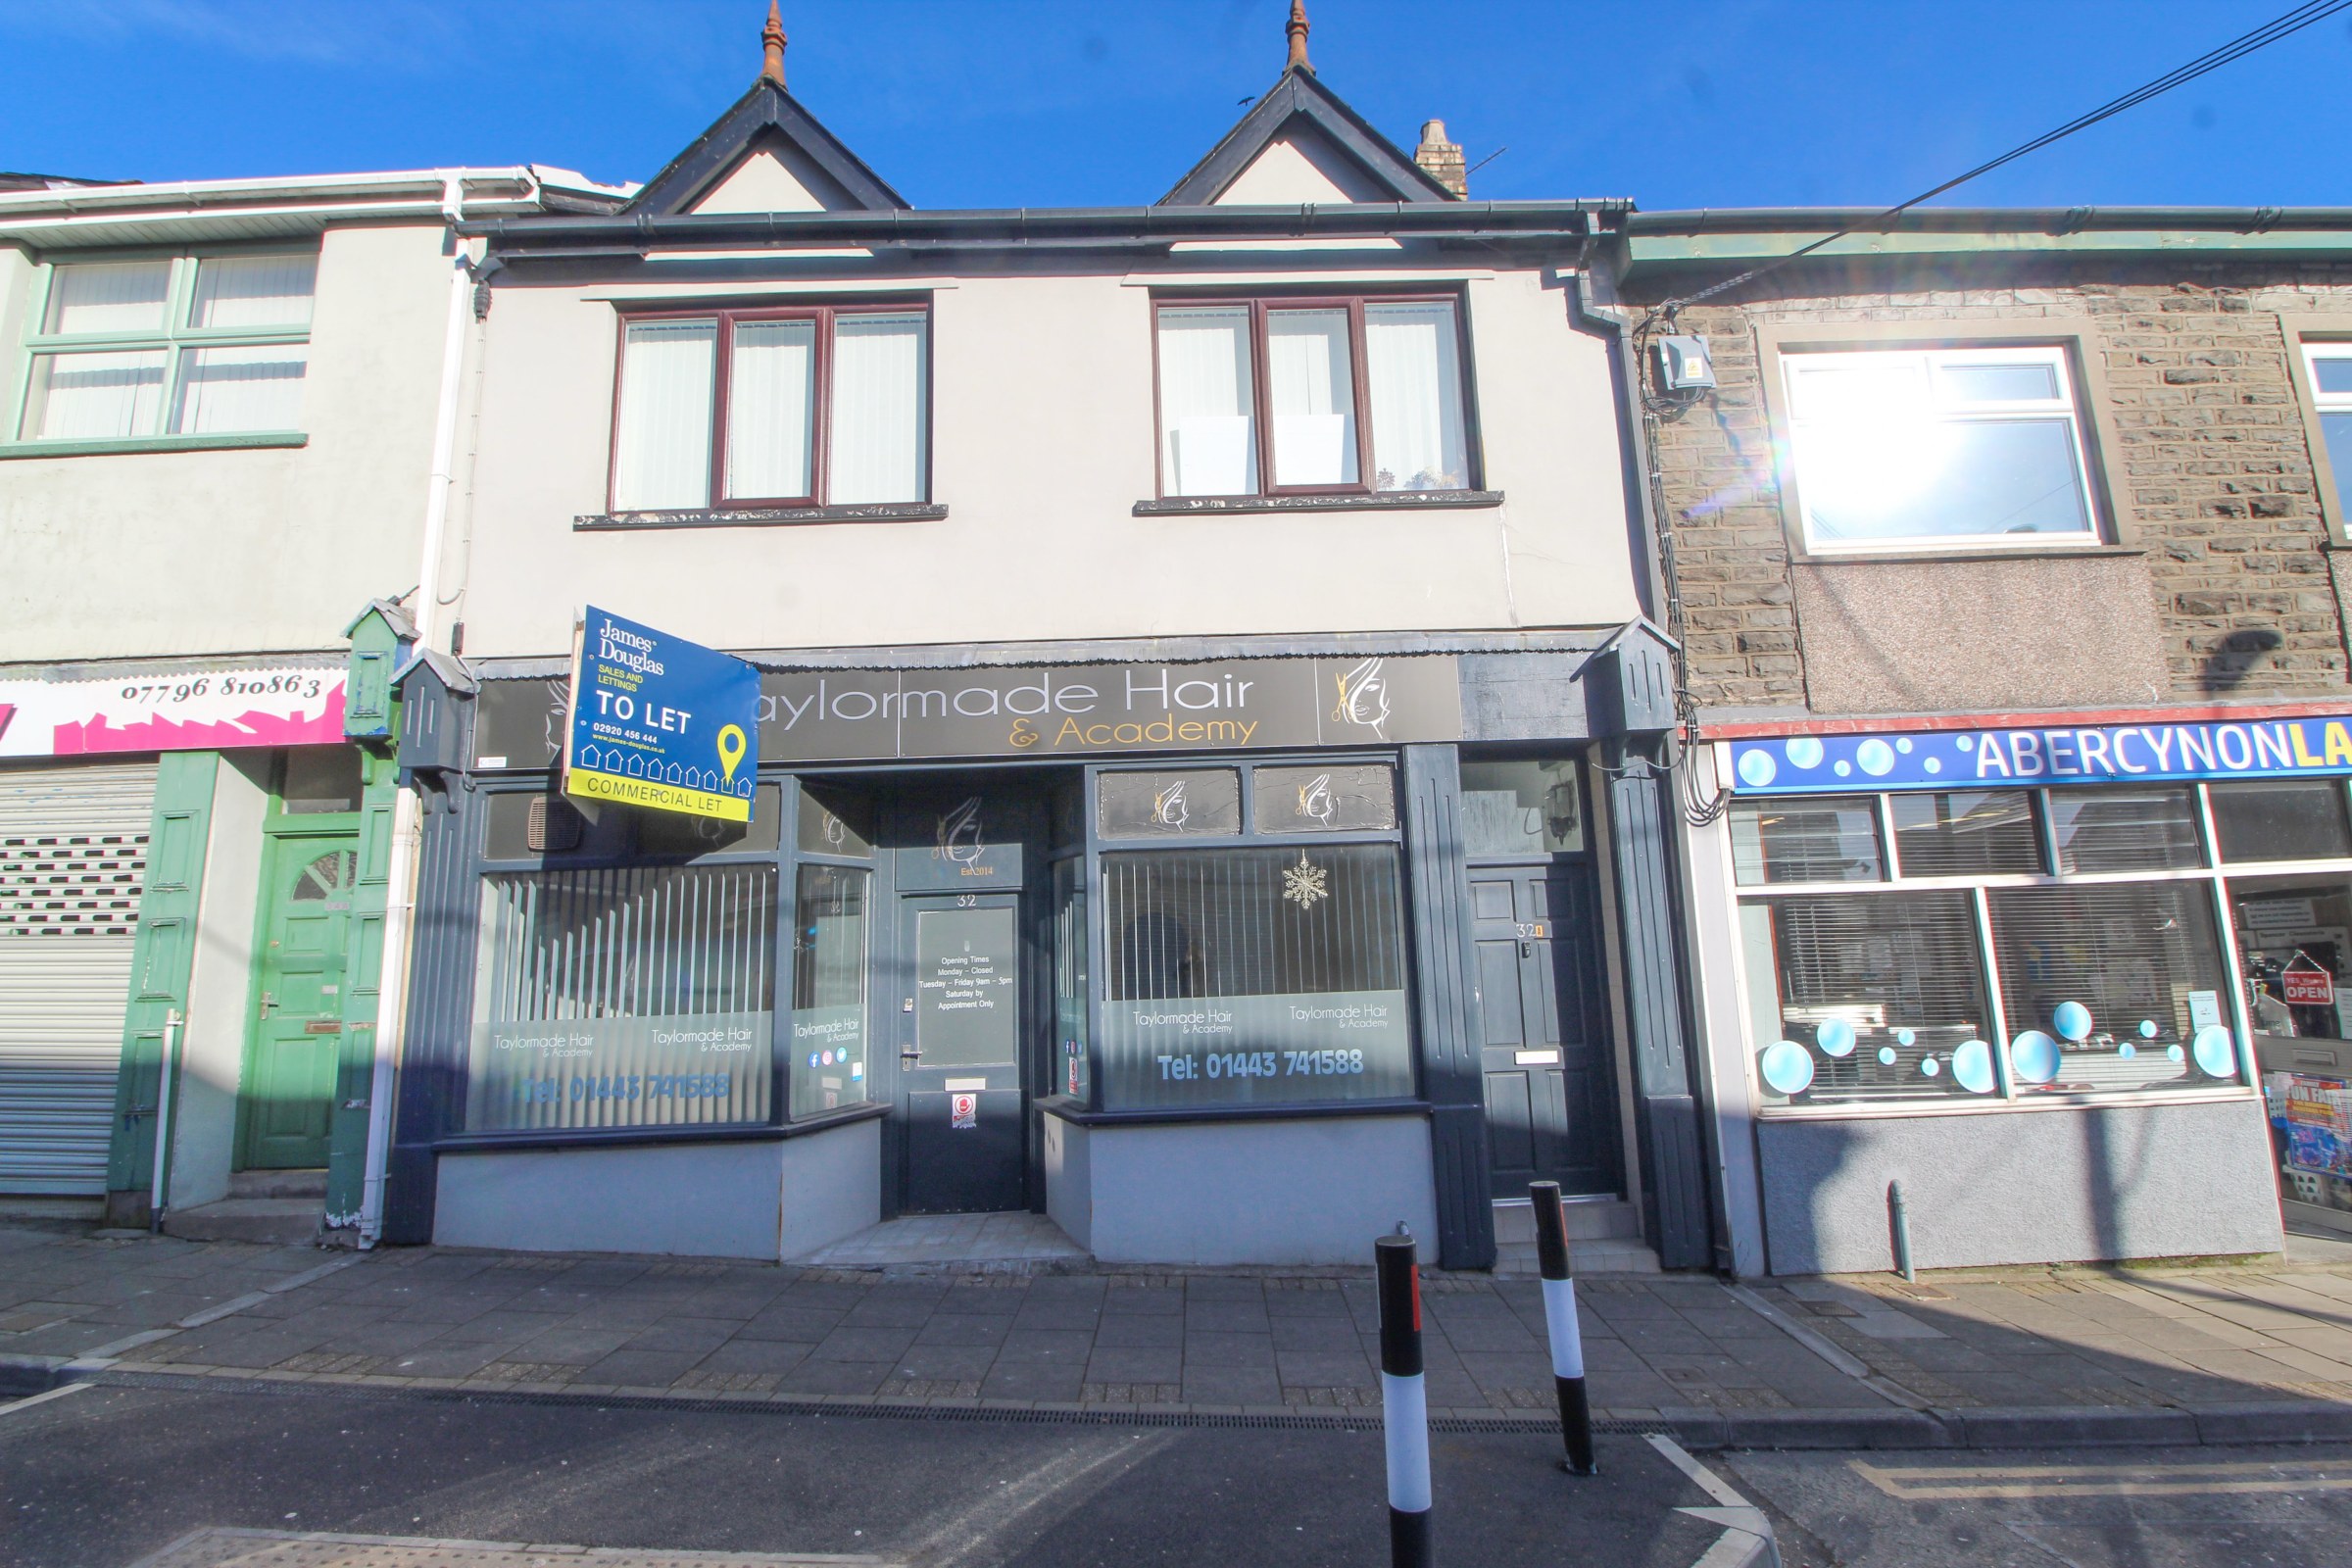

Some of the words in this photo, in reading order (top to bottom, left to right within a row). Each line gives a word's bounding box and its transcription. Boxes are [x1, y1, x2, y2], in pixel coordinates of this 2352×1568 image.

[599, 638, 664, 676] Douglas
[598, 674, 637, 692] LETTINGS
[599, 664, 625, 679] SALES
[626, 669, 643, 684] AND
[122, 677, 210, 705] 07796
[220, 674, 321, 699] 810863
[760, 671, 1099, 730] aylormade
[1125, 668, 1254, 711] Hair
[596, 689, 634, 720] TO
[646, 702, 692, 735] LET
[593, 722, 622, 736] 02920
[624, 729, 640, 740] 456
[643, 734, 658, 744] 444
[1008, 717, 1039, 748] &
[1054, 712, 1259, 747] Academy
[592, 733, 665, 755] www.james-douglas.co.uk
[587, 777, 692, 808] COMMERCIAL
[698, 796, 722, 812] LET
[956, 894, 977, 907] 32
[941, 956, 968, 966] Opening
[937, 967, 962, 977] Monday
[971, 966, 994, 975] Closed
[919, 980, 947, 989] Tuesday
[954, 978, 974, 988] Friday
[975, 977, 990, 986] 9am
[998, 977, 1013, 986] 5pm
[2286, 986, 2328, 999] OPEN
[945, 989, 974, 998] Saturday
[975, 989, 984, 998] by
[937, 1000, 978, 1011] Appointment
[979, 1000, 995, 1009] Only
[1289, 1004, 1361, 1021] Taylormade
[1363, 1004, 1388, 1018] Hair
[1132, 1009, 1205, 1028] Taylormade
[1207, 1008, 1232, 1023] Hair
[1348, 1017, 1389, 1030] Academy
[651, 1028, 725, 1046] Taylormade
[727, 1027, 753, 1042] Hair
[793, 1019, 843, 1039] Taylormade
[844, 1017, 859, 1031] Hair
[833, 1031, 859, 1042] Academy
[1192, 1022, 1233, 1035] Academy
[493, 1033, 566, 1052] Taylormade
[568, 1033, 594, 1047] Hair
[710, 1041, 753, 1053] Academy
[551, 1048, 594, 1058] Academy
[1157, 1054, 1199, 1080] Tel:
[1206, 1052, 1277, 1079] 01443
[1283, 1049, 1364, 1076] 741588
[521, 1077, 561, 1103] Tel:
[569, 1075, 641, 1102] 01443
[649, 1072, 730, 1100] 741588
